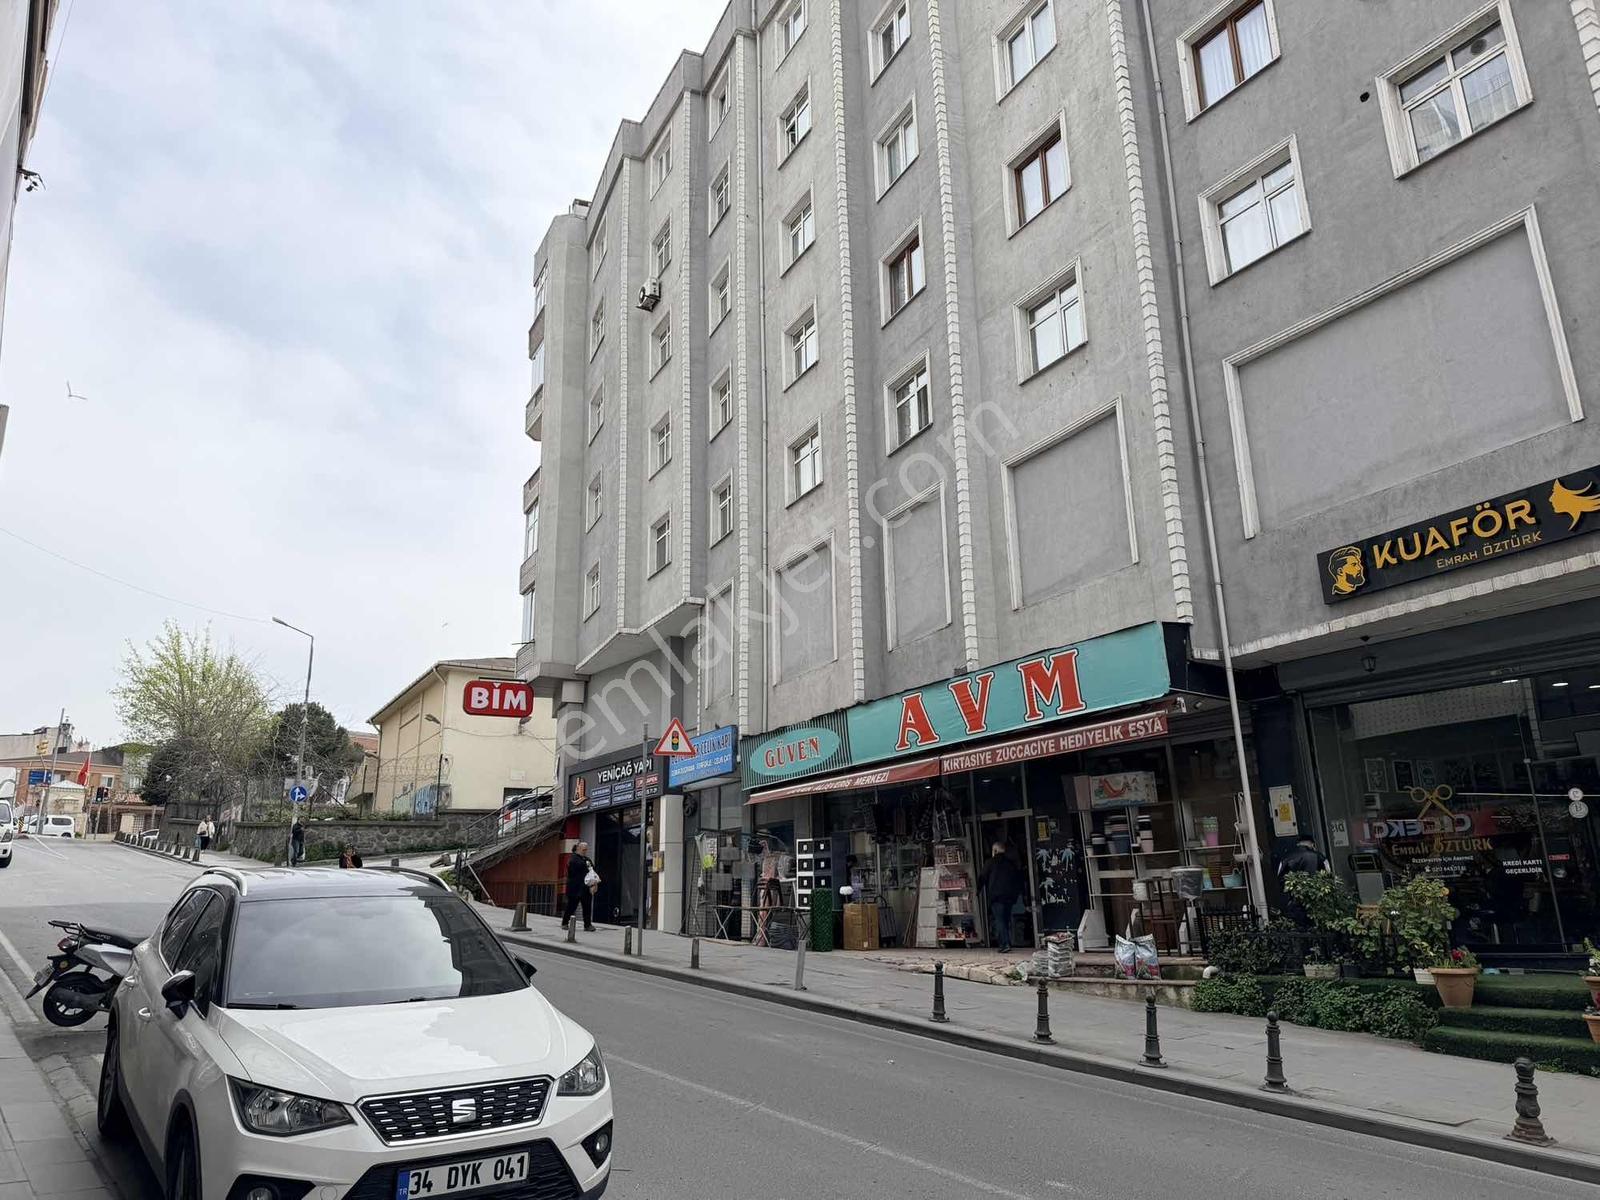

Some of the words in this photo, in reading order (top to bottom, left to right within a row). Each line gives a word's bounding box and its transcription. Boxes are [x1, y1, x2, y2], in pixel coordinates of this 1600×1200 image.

[1373, 500, 1536, 569] KUAFÖR
[1437, 551, 1477, 569] EMRAH
[1483, 530, 1542, 556] ÖZTÜRK
[471, 682, 526, 711] BİM
[1060, 725, 1123, 750] HEDİYELİK
[1128, 717, 1163, 738] EŞYA
[764, 736, 820, 769] GÜVEN
[597, 760, 632, 783] YENİÇAĞ
[1523, 858, 1543, 867] KARTI
[399, 1187, 408, 1195] TR
[409, 1170, 433, 1195] 34
[446, 1162, 482, 1190] DYK
[493, 1155, 525, 1181] 041
